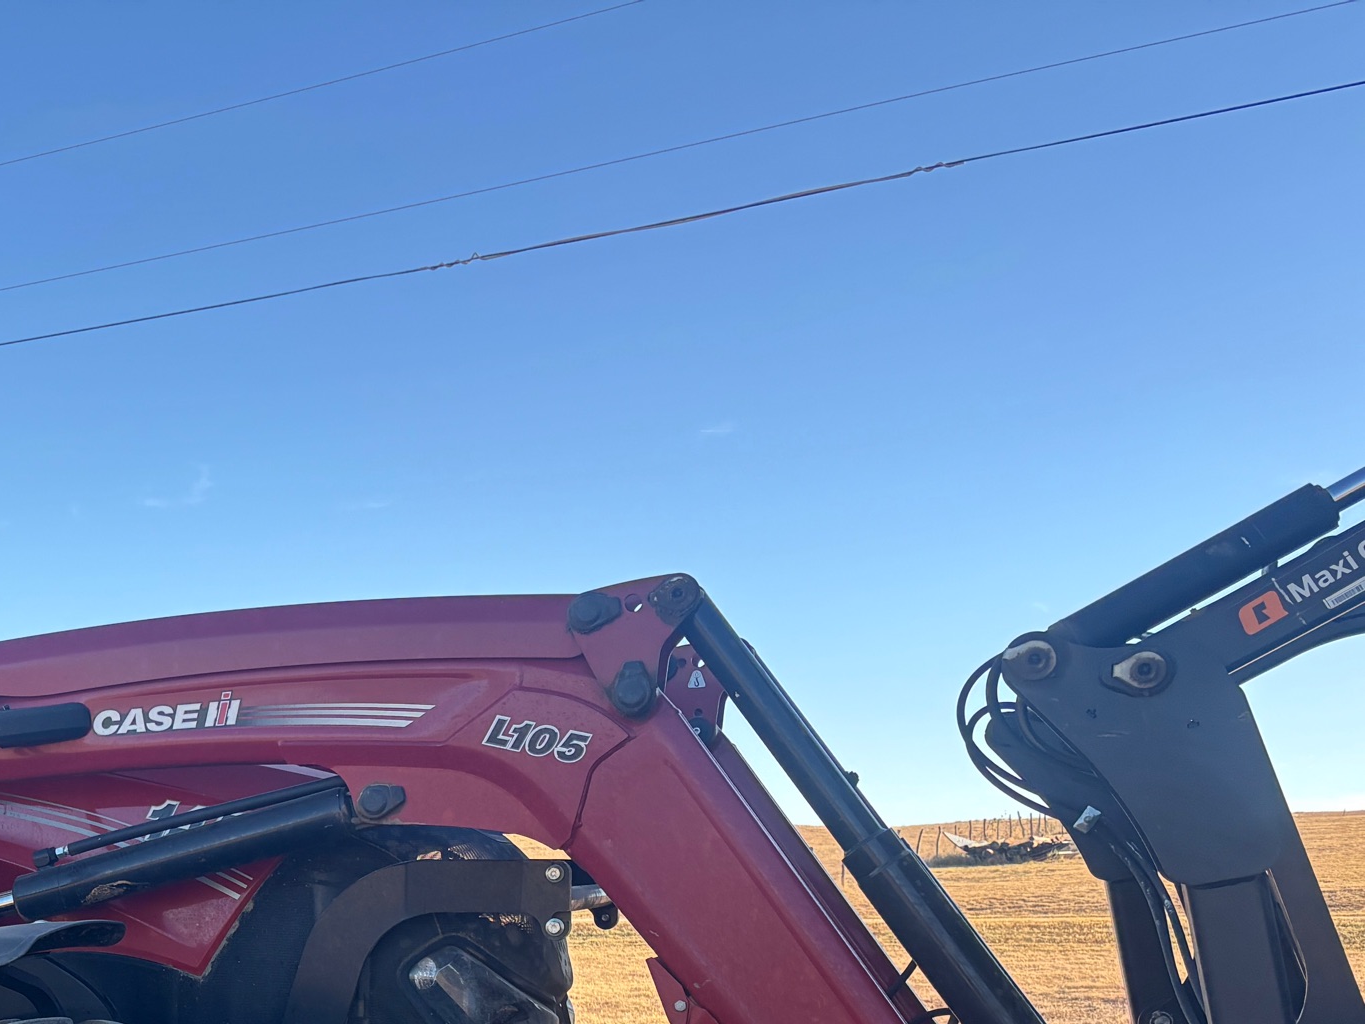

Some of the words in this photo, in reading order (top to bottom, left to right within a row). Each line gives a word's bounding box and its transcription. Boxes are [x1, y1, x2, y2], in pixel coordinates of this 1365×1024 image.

[1287, 550, 1359, 603] Maxi
[92, 703, 203, 736] CASE
[482, 715, 593, 764] L105
